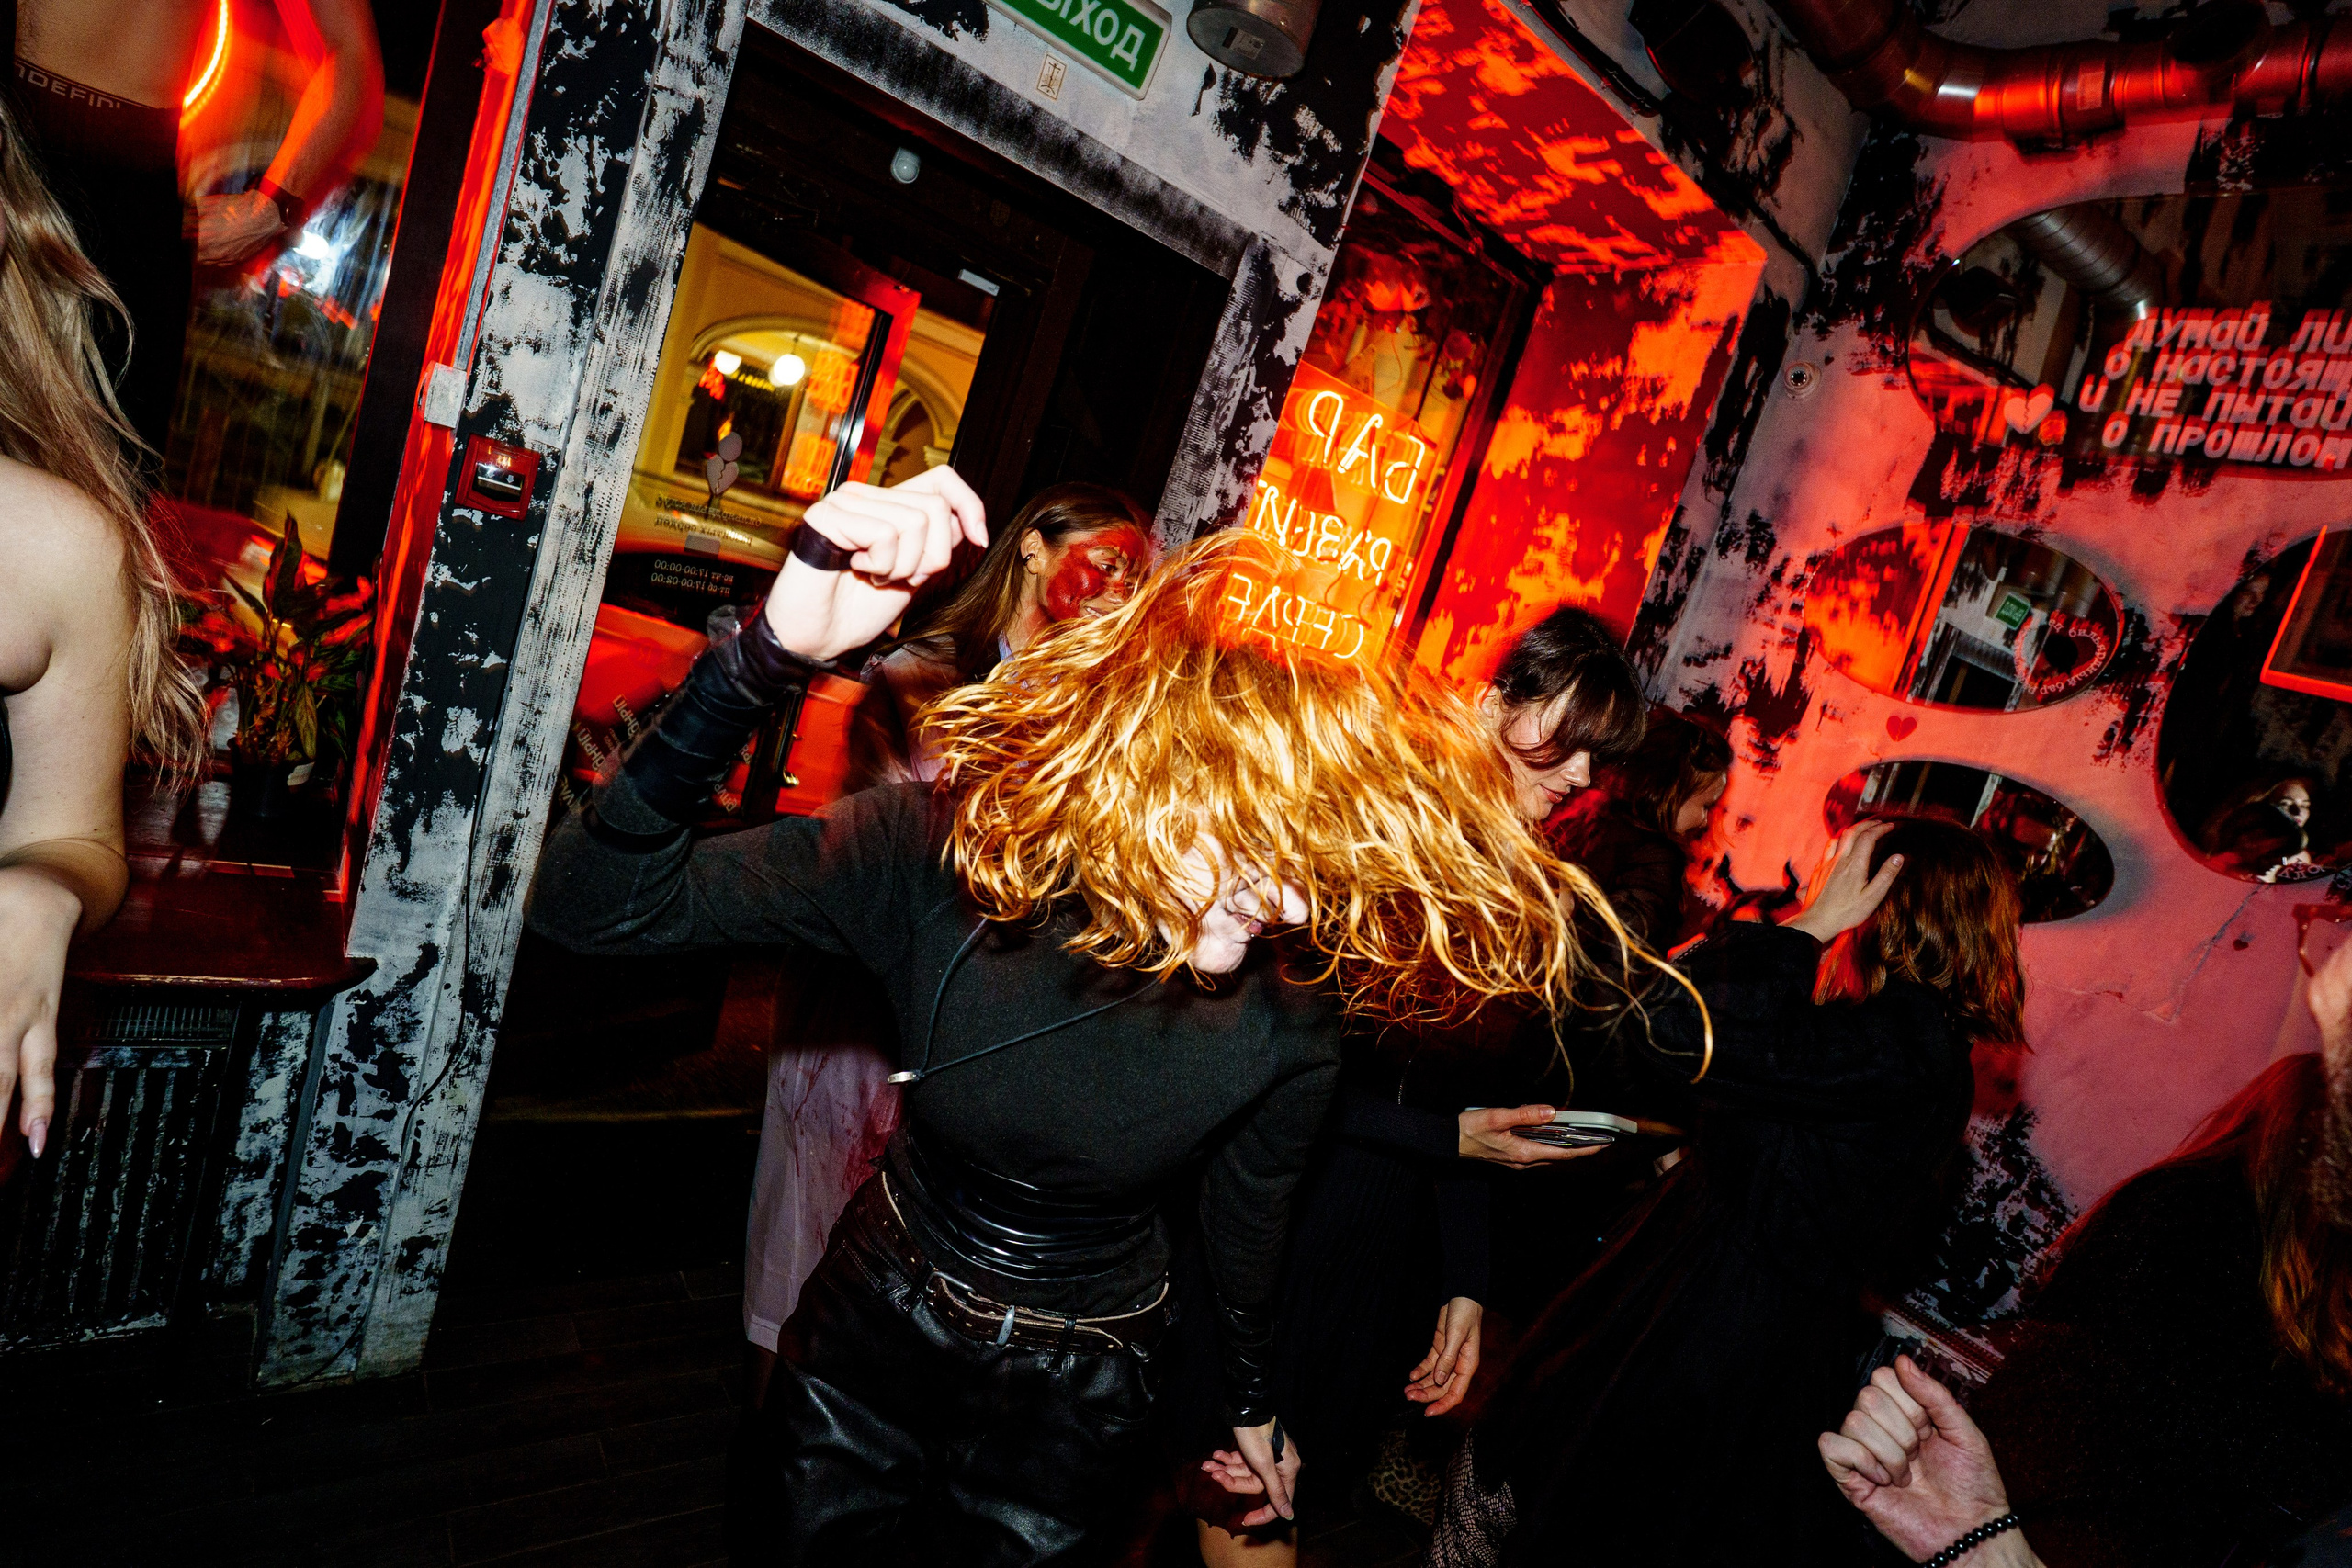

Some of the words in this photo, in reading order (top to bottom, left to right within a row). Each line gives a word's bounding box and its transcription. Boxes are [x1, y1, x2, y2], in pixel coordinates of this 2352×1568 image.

[16, 63, 120, 108] DEFIN
[2104, 351, 2132, 380] О
[2079, 382, 2109, 412] И
[2125, 387, 2183, 418] НЕ
[2102, 420, 2129, 448] О
[2148, 423, 2352, 469] ПРОШЛОМ
[2040, 682, 2064, 695] бар
